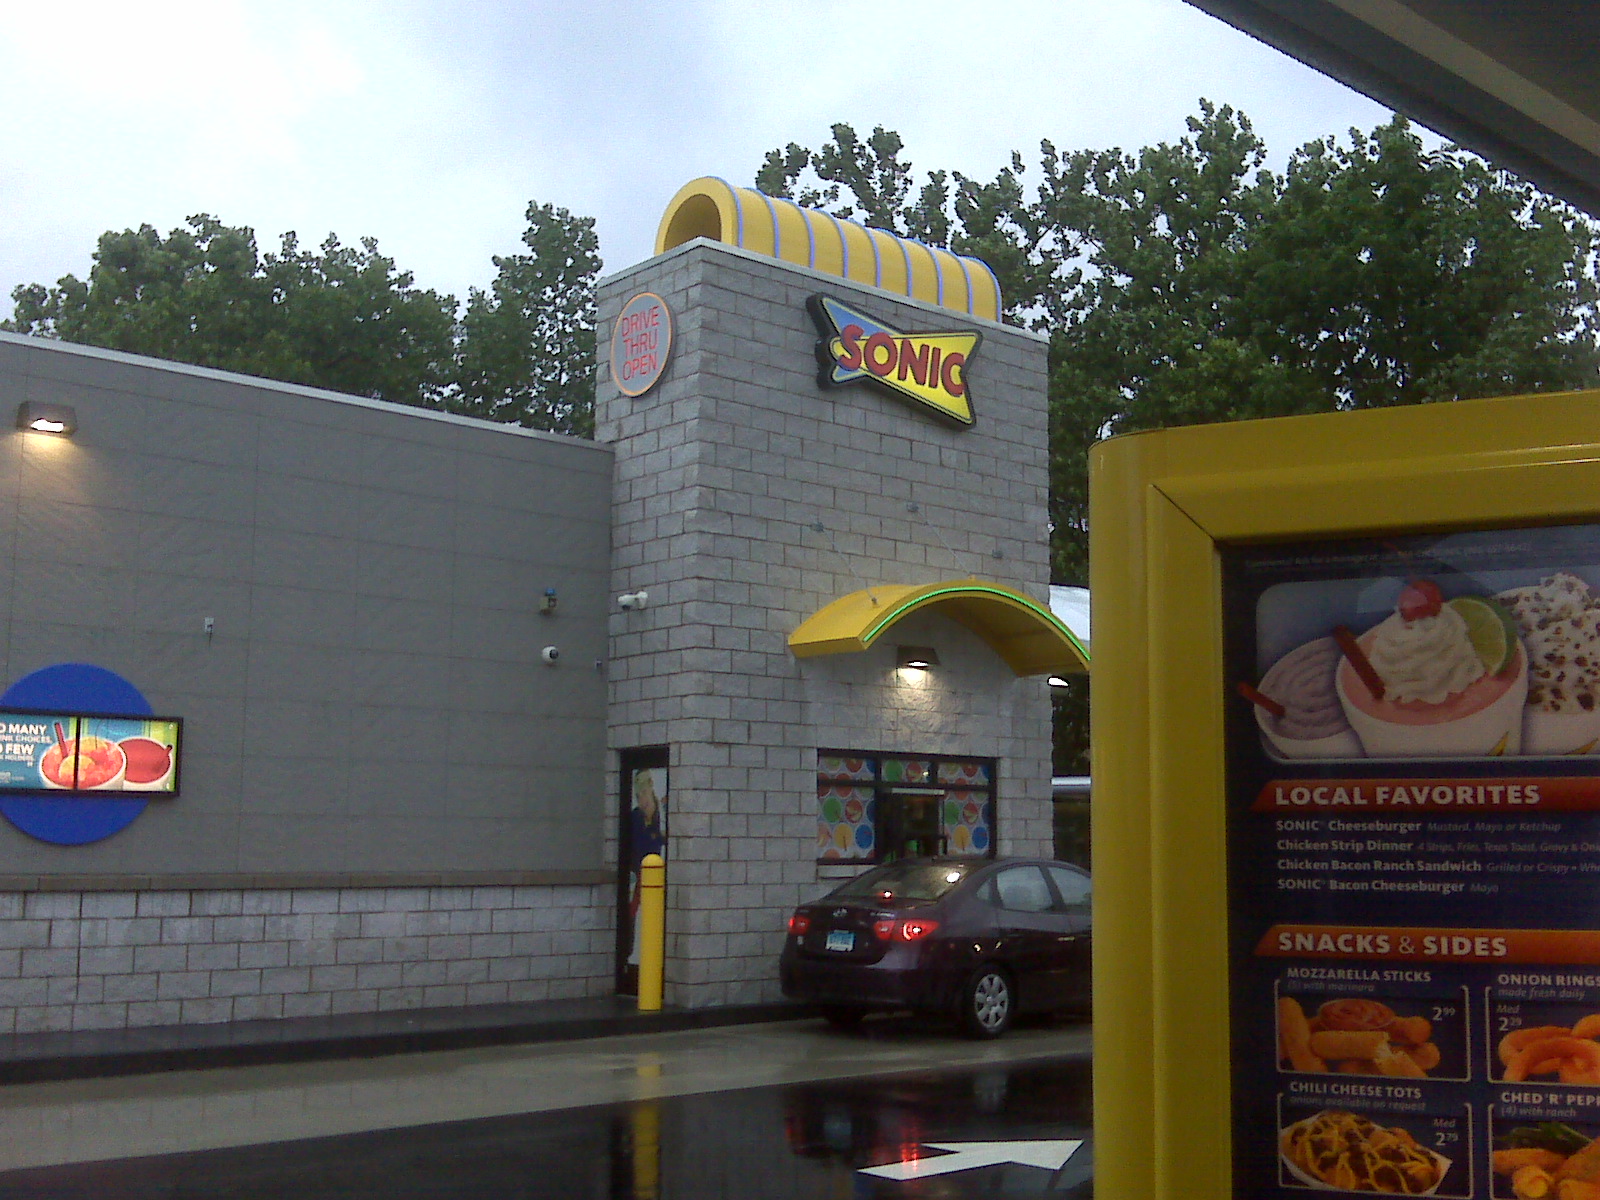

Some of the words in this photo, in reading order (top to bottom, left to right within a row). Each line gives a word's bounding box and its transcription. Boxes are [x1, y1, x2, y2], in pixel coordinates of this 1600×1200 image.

[622, 305, 660, 337] DRIVE
[623, 328, 658, 359] THRU
[622, 351, 658, 381] OPEN
[838, 324, 965, 397] SONIC
[9, 723, 47, 736] MANY
[5, 743, 35, 755] FEW
[1275, 786, 1368, 806] LOCAL
[1375, 784, 1541, 805] FAVORITES
[1276, 820, 1320, 831] SONIC
[1328, 820, 1422, 834] Cheeseburger
[1277, 839, 1329, 851] Chicken
[1330, 839, 1364, 853] Strip
[1367, 839, 1414, 851] Dinner
[1277, 859, 1329, 870] Chicken
[1331, 860, 1371, 871] Bacon
[1373, 860, 1415, 871] Ranch
[1417, 860, 1482, 872] Sandwich
[1277, 879, 1322, 890] SONIC
[1329, 880, 1369, 890] Bacon
[1371, 879, 1465, 895] Cheeseburger
[1278, 932, 1391, 954] SNACKS
[1399, 935, 1415, 954] &
[1423, 936, 1508, 957] SIDES
[1286, 967, 1380, 981] MOZZARELLA
[1383, 970, 1432, 982] STICKS
[1497, 974, 1552, 986] ONION
[1556, 975, 1600, 987] RINGS
[1498, 988, 1527, 997] made
[1289, 1081, 1327, 1094] CHILI
[1330, 1083, 1383, 1097] CHEESE
[1386, 1086, 1422, 1099] TOTS
[1501, 1091, 1543, 1104] CHED
[1519, 1106, 1543, 1116] with
[1545, 1106, 1577, 1117] ranch
